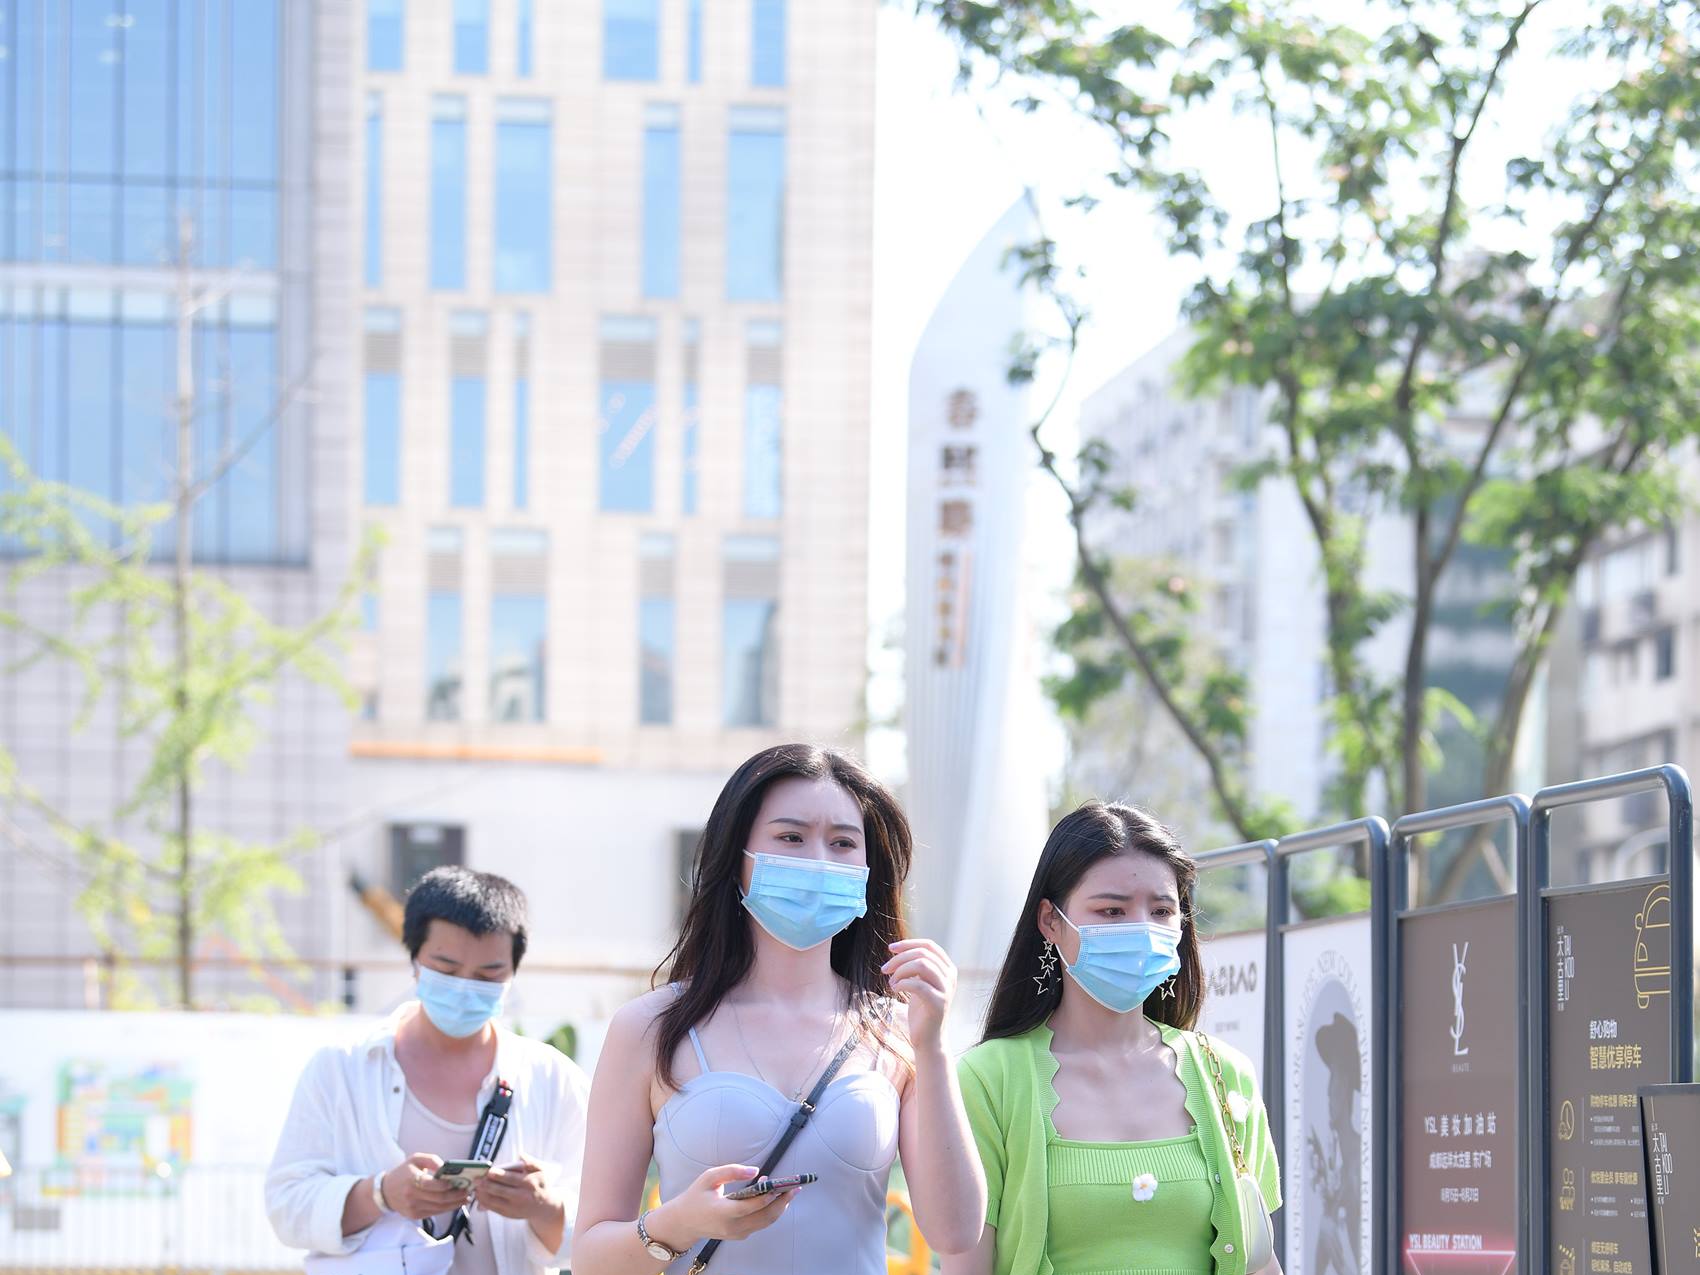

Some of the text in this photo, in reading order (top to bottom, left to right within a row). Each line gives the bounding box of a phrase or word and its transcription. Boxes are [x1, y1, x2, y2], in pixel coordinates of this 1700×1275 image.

[1589, 1044, 1642, 1070] 智慧优享停车
[1440, 1112, 1497, 1136] 美妆加油站
[1652, 1133, 1664, 1195] 太古里
[1408, 1234, 1483, 1250] YSL BEAUTY STATION
